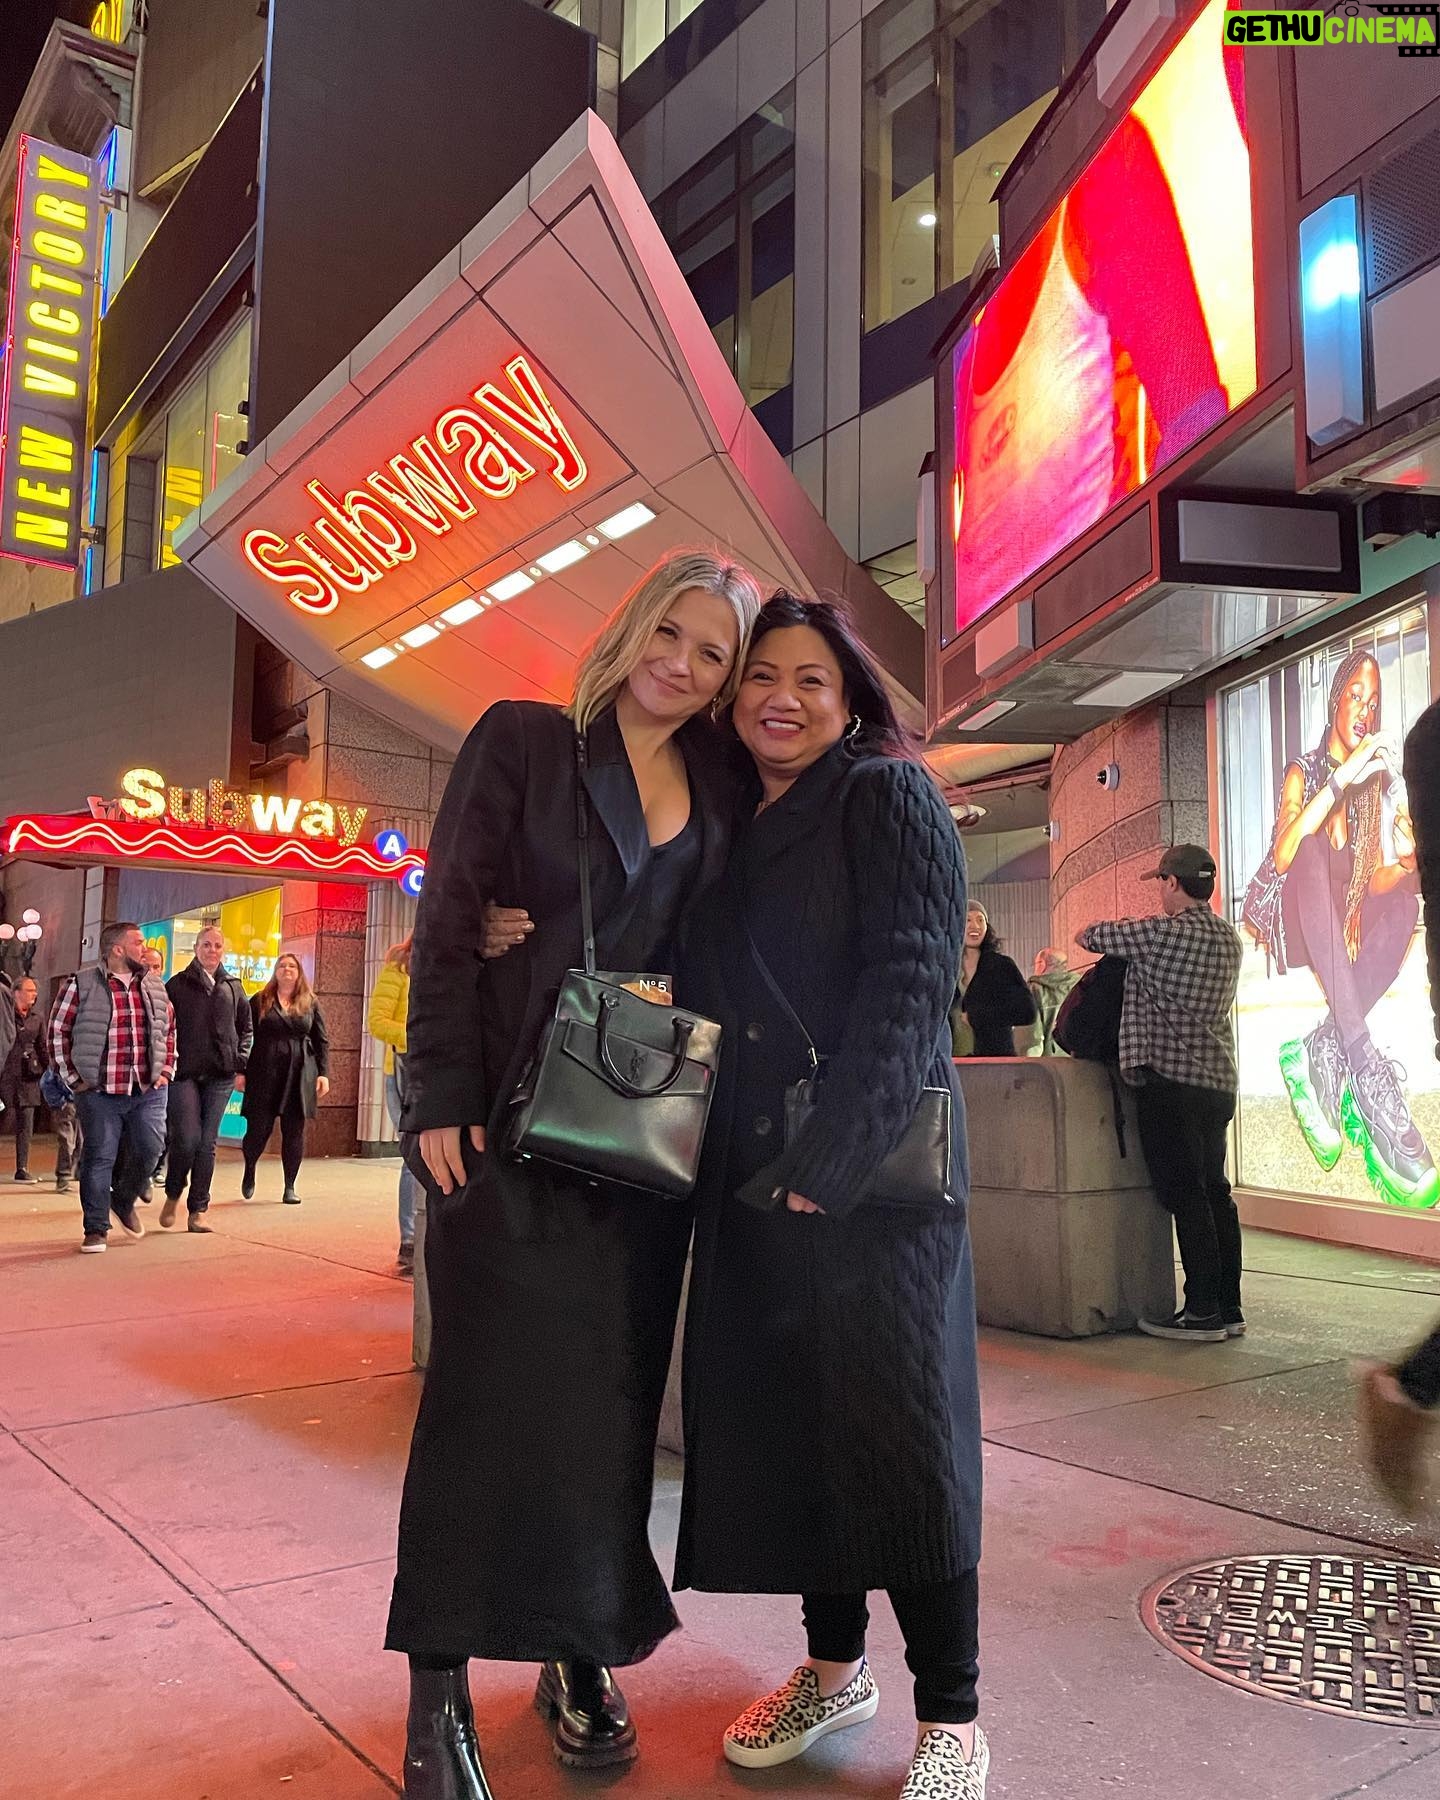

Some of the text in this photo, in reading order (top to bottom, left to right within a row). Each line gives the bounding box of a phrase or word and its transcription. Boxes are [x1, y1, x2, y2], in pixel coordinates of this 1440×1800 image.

[14, 154, 89, 550] NEW VICTORY
[242, 355, 588, 616] Subway
[118, 767, 369, 848] Subway
[382, 834, 402, 858] A
